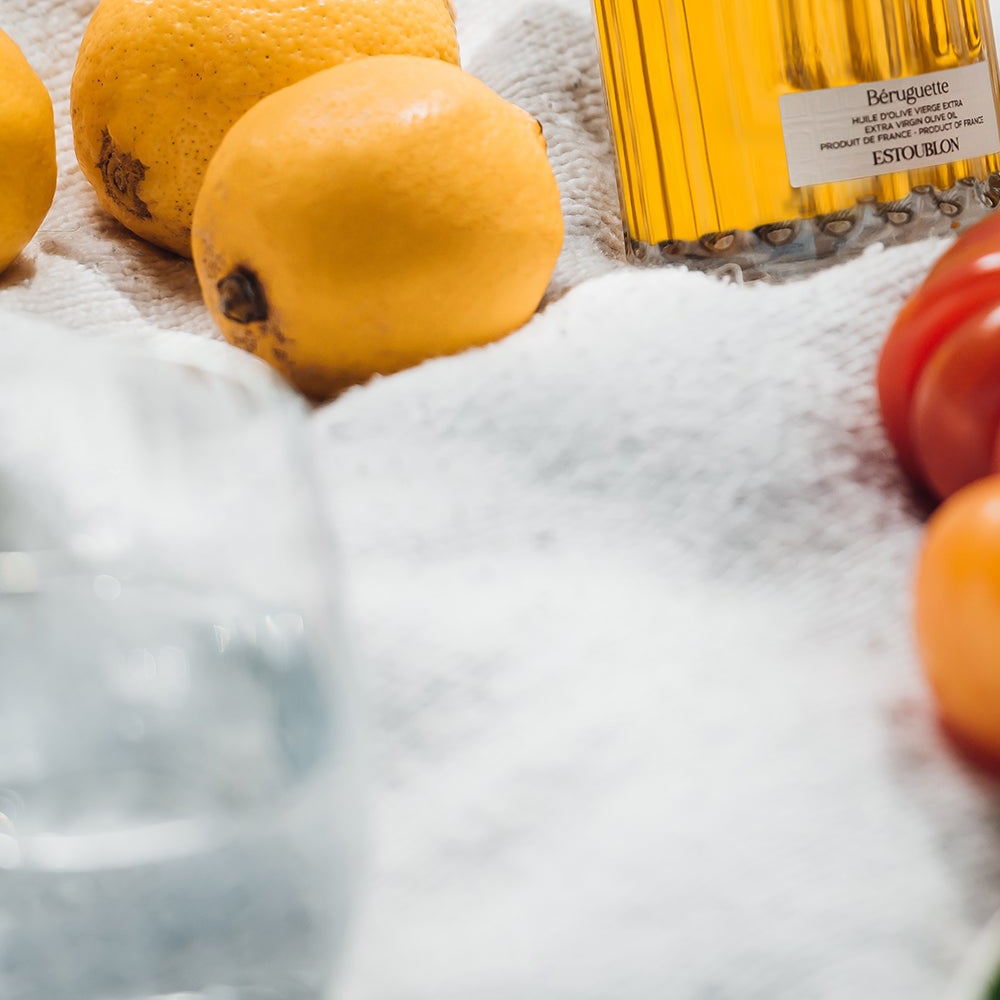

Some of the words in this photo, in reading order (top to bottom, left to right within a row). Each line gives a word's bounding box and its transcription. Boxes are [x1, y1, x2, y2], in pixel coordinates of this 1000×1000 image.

[866, 80, 950, 106] Béruguette
[852, 113, 878, 125] HUILE
[879, 108, 913, 121] D'OLIVE
[914, 102, 942, 115] VIERGE
[942, 99, 964, 110] EXTRA
[864, 122, 894, 134] EXTRA
[895, 117, 923, 129] VIRGIN
[924, 112, 946, 124] OLIVE
[946, 111, 958, 120] OIL
[820, 137, 860, 151] PRODUIT
[862, 135, 875, 145] DE
[877, 129, 912, 142] FRANCE
[918, 122, 953, 135] PRODUCT
[954, 119, 963, 130] OF
[963, 115, 985, 127] FRANCE
[872, 137, 960, 166] ESTOUBLON
